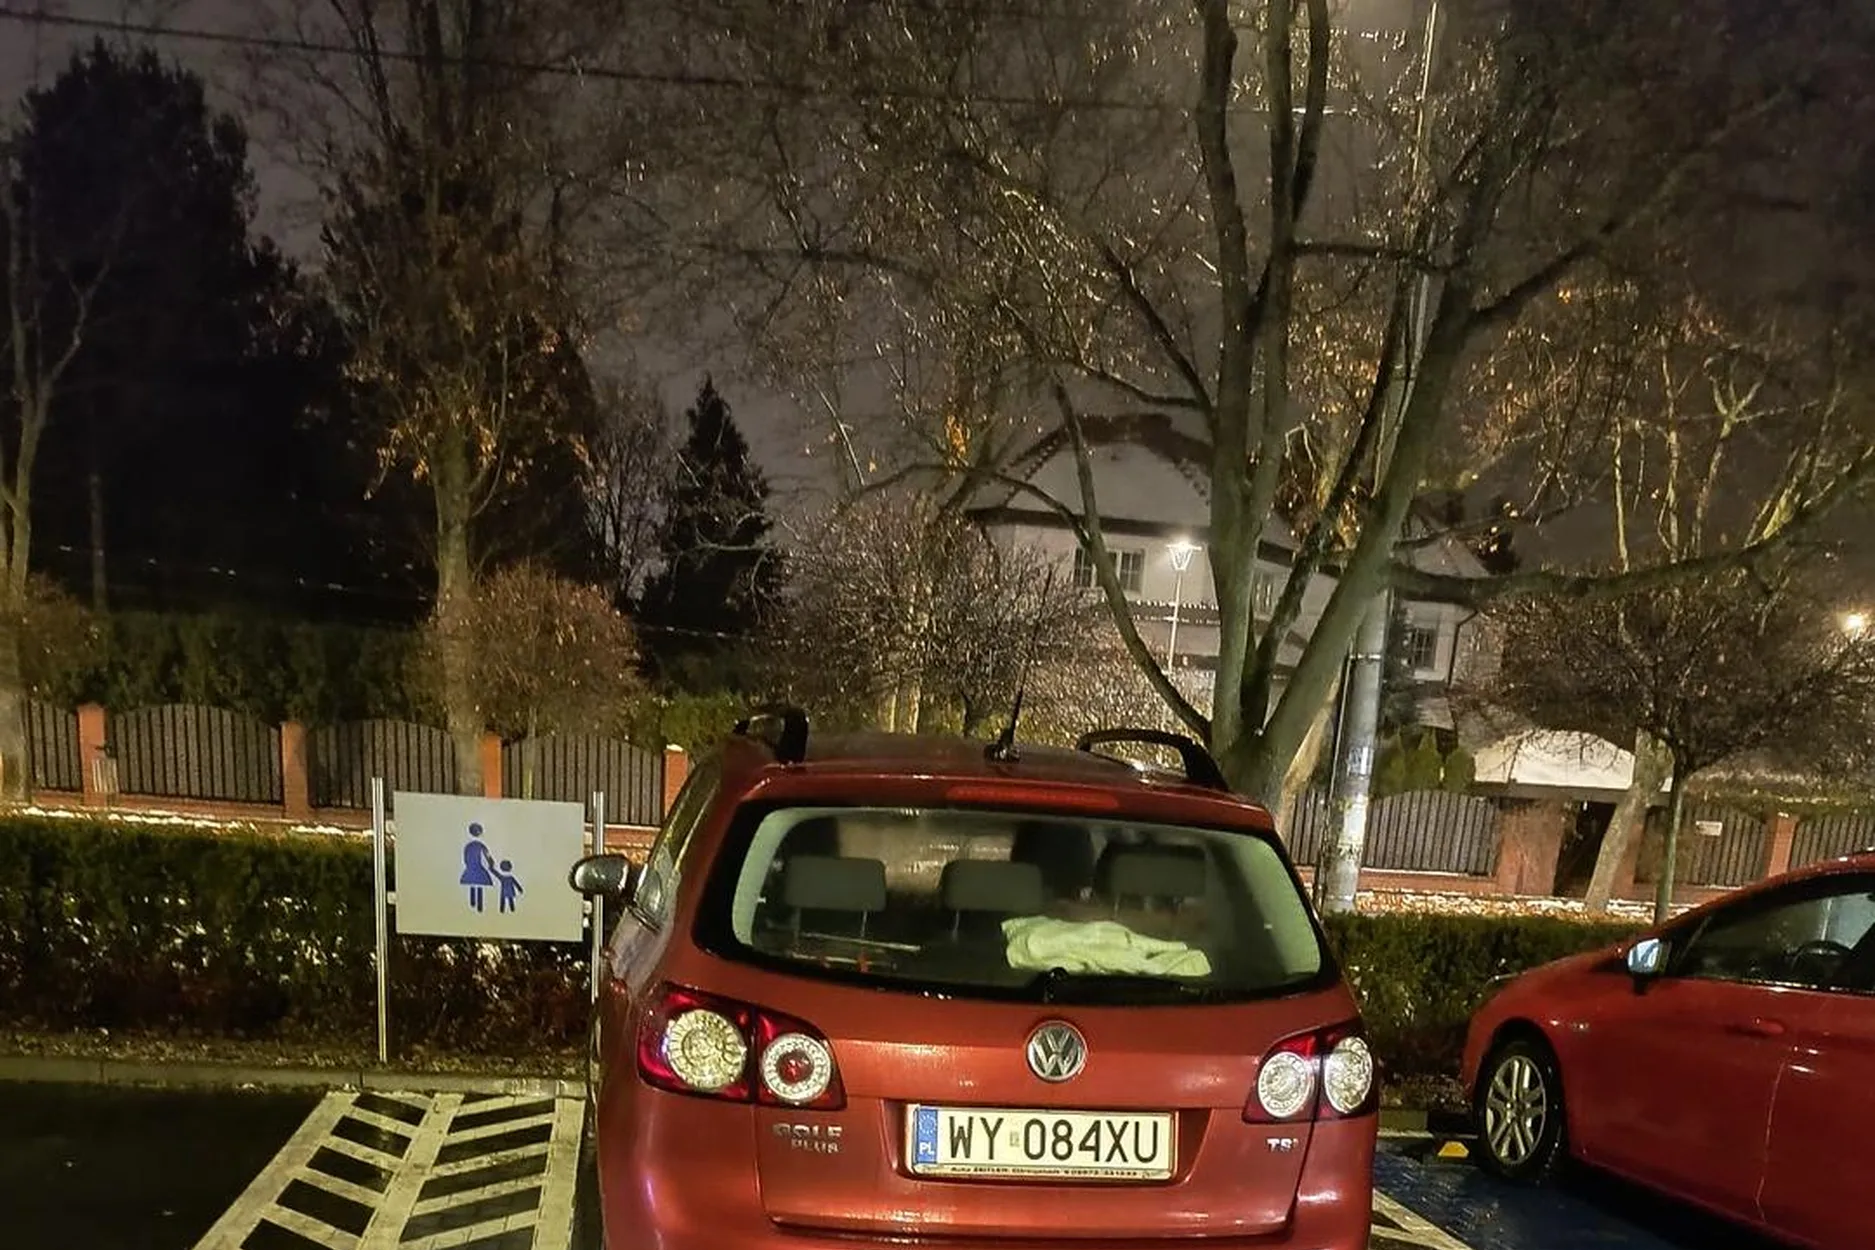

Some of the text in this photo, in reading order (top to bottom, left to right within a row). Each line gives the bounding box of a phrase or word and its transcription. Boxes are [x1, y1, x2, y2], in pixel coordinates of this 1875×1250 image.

[919, 1143, 935, 1155] PL
[948, 1116, 1159, 1163] WY 084XU
